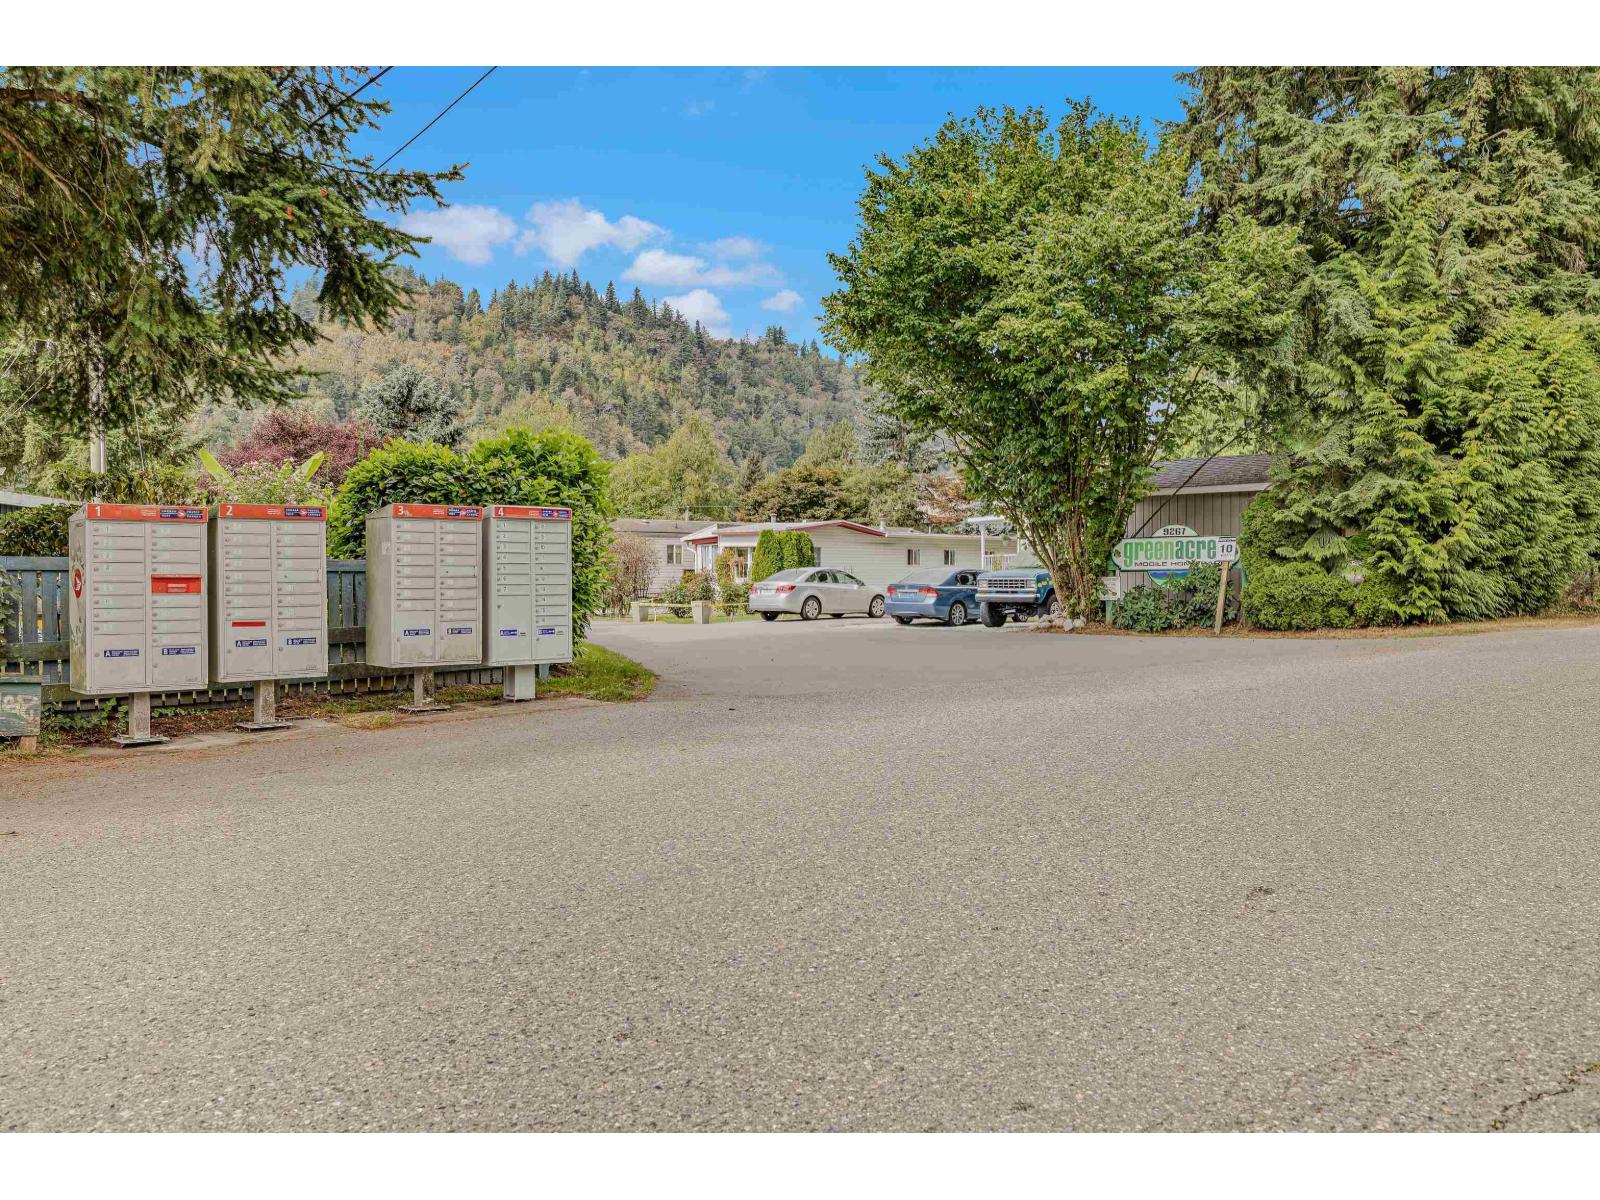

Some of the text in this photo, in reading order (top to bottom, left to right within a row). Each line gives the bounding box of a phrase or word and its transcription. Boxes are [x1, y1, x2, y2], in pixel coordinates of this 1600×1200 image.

[95, 505, 100, 516] 1
[226, 505, 232, 516] 2
[398, 505, 403, 515] 3
[498, 507, 504, 516] 4
[1163, 528, 1186, 536] 9267
[1220, 544, 1233, 553] 10
[1123, 540, 1217, 568] greenacre
[105, 649, 111, 657] A
